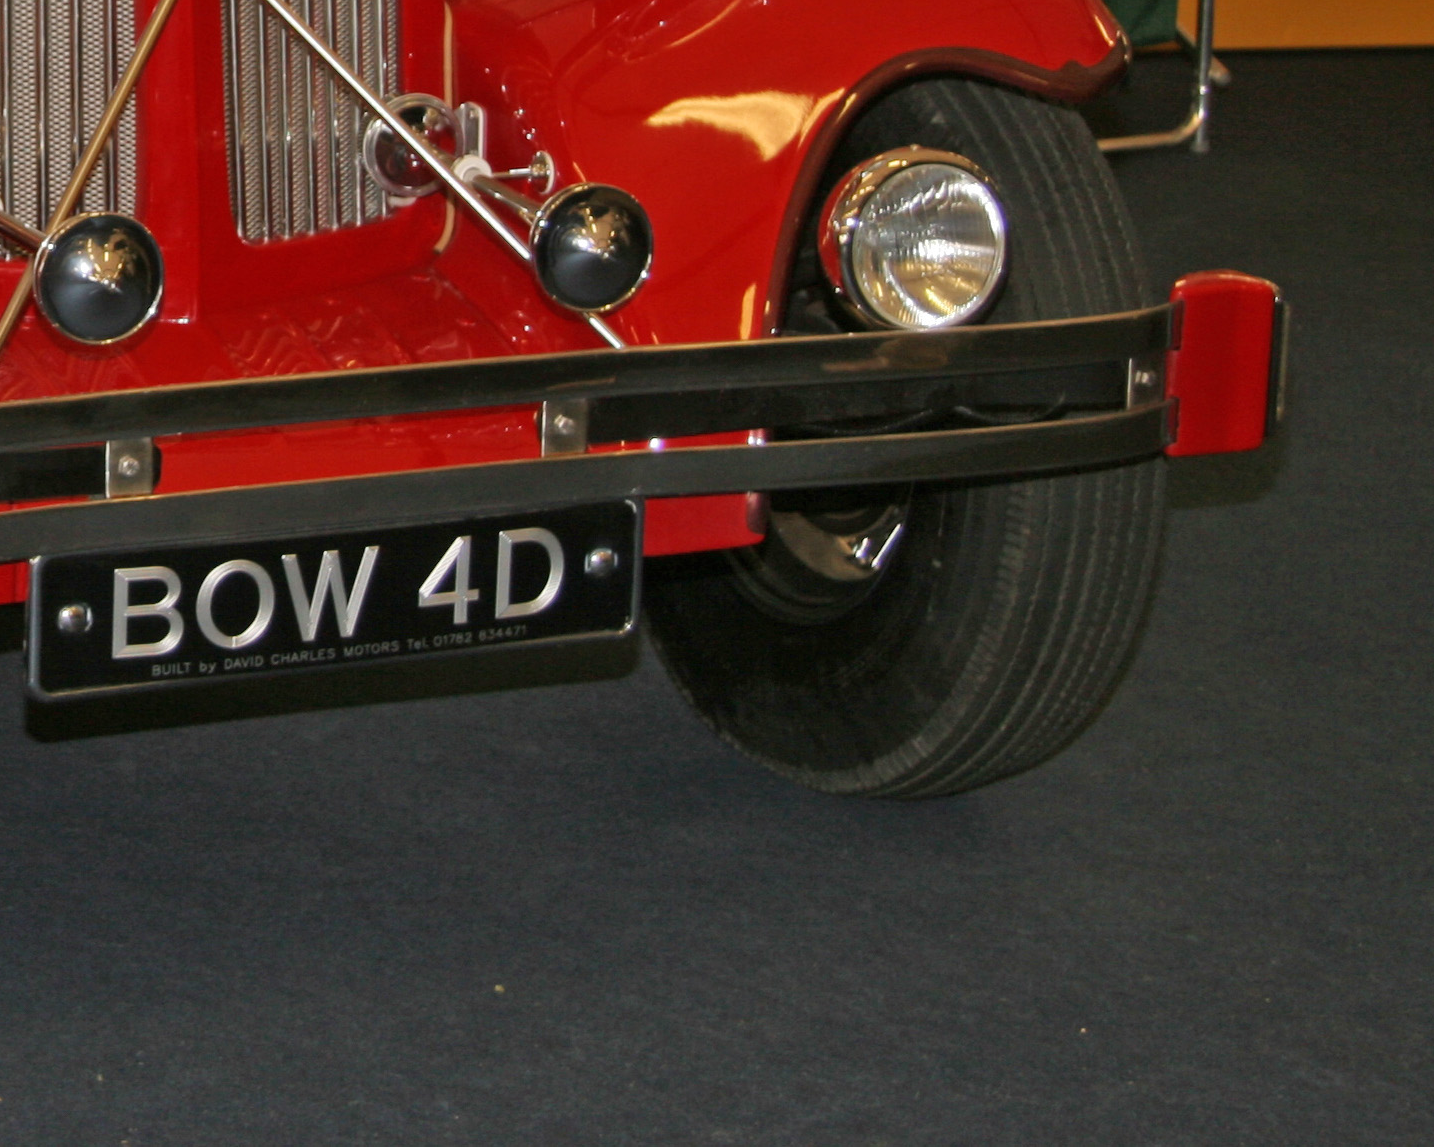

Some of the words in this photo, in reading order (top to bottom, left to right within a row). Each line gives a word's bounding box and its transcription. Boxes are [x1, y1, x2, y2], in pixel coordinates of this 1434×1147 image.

[112, 545, 379, 659] BOW
[418, 527, 565, 624] 4D
[151, 662, 191, 676] BUILT
[199, 661, 216, 674] by
[224, 656, 264, 670] DAVID
[271, 648, 336, 665] CHARLES
[343, 640, 400, 656] MOTORS
